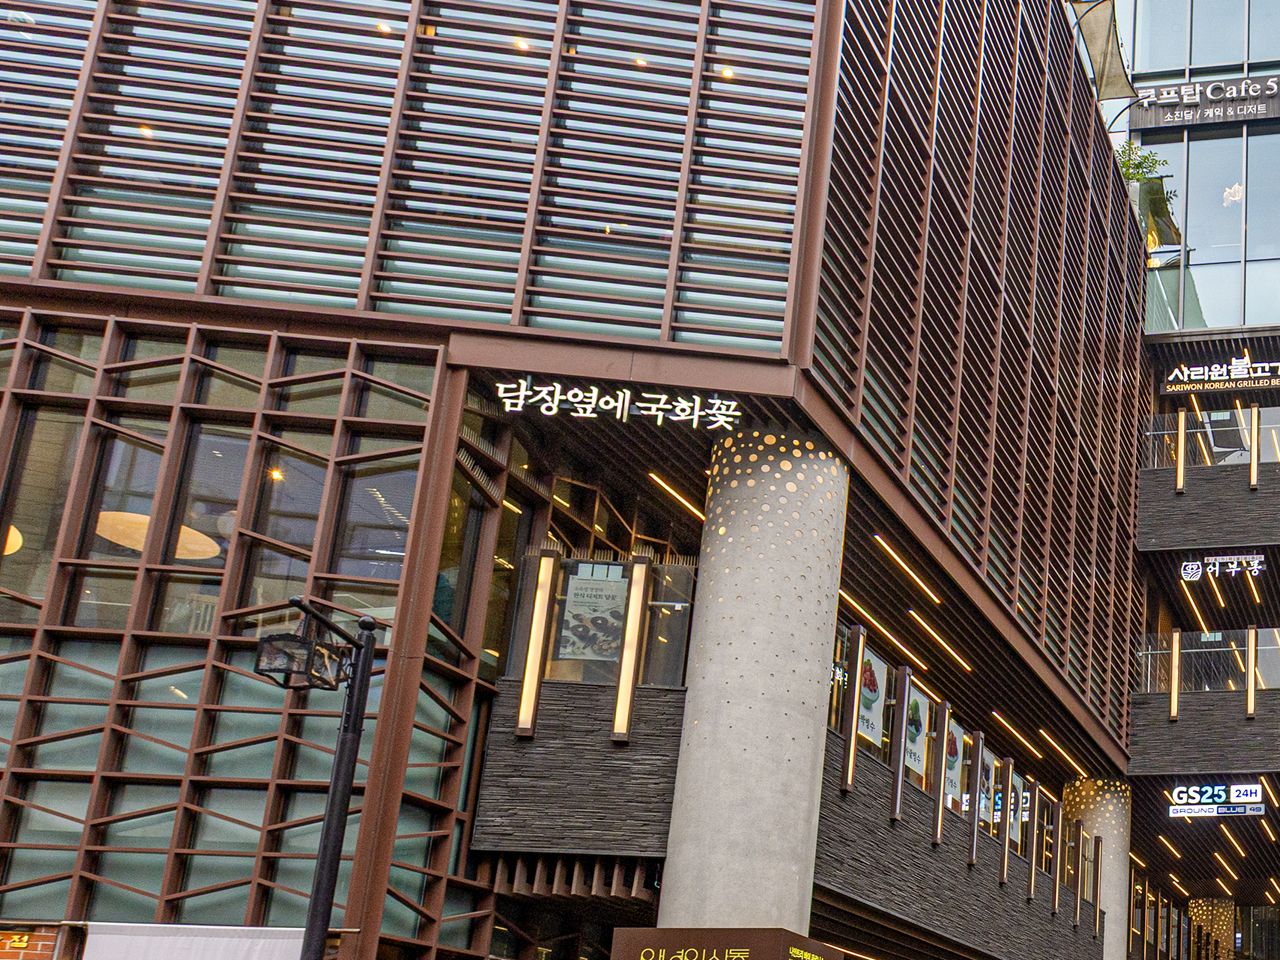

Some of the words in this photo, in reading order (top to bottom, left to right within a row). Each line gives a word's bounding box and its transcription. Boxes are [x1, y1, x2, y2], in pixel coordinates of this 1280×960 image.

[1138, 83, 1203, 107] 루프탑
[1206, 79, 1261, 100] Cafe
[1203, 107, 1224, 118] 케익
[1226, 107, 1234, 116] &
[1237, 103, 1267, 115] 디저트
[1166, 383, 1203, 392] SARIWON
[1204, 381, 1236, 390] KOREAN
[1236, 379, 1270, 388] GRILLED
[496, 379, 742, 431] 담장옆에국화꽃
[1172, 785, 1227, 805] GS25
[1235, 788, 1258, 798] 24H
[1217, 806, 1245, 814] BLUE
